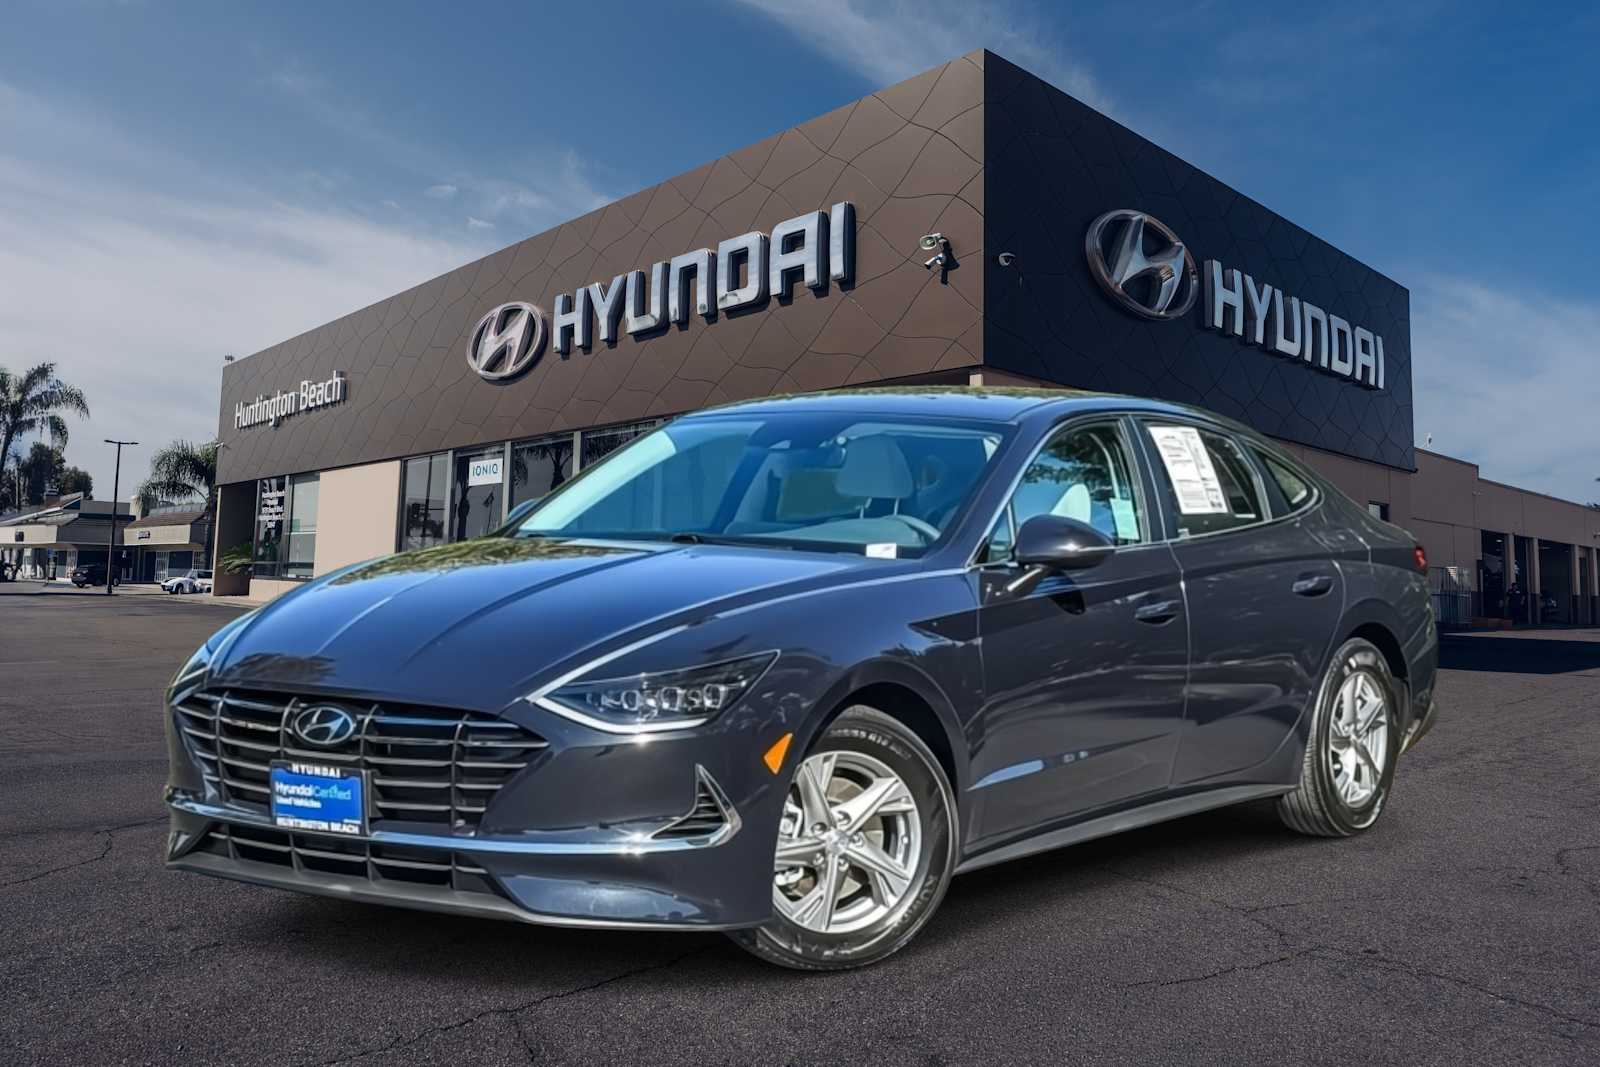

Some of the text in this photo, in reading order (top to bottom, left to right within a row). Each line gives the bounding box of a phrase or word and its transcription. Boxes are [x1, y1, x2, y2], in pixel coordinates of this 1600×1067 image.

[553, 201, 855, 354] HYUNDAI
[1205, 259, 1385, 390] HYUNDAI
[234, 370, 343, 429] Huntington Beach
[472, 463, 499, 477] IONIQ
